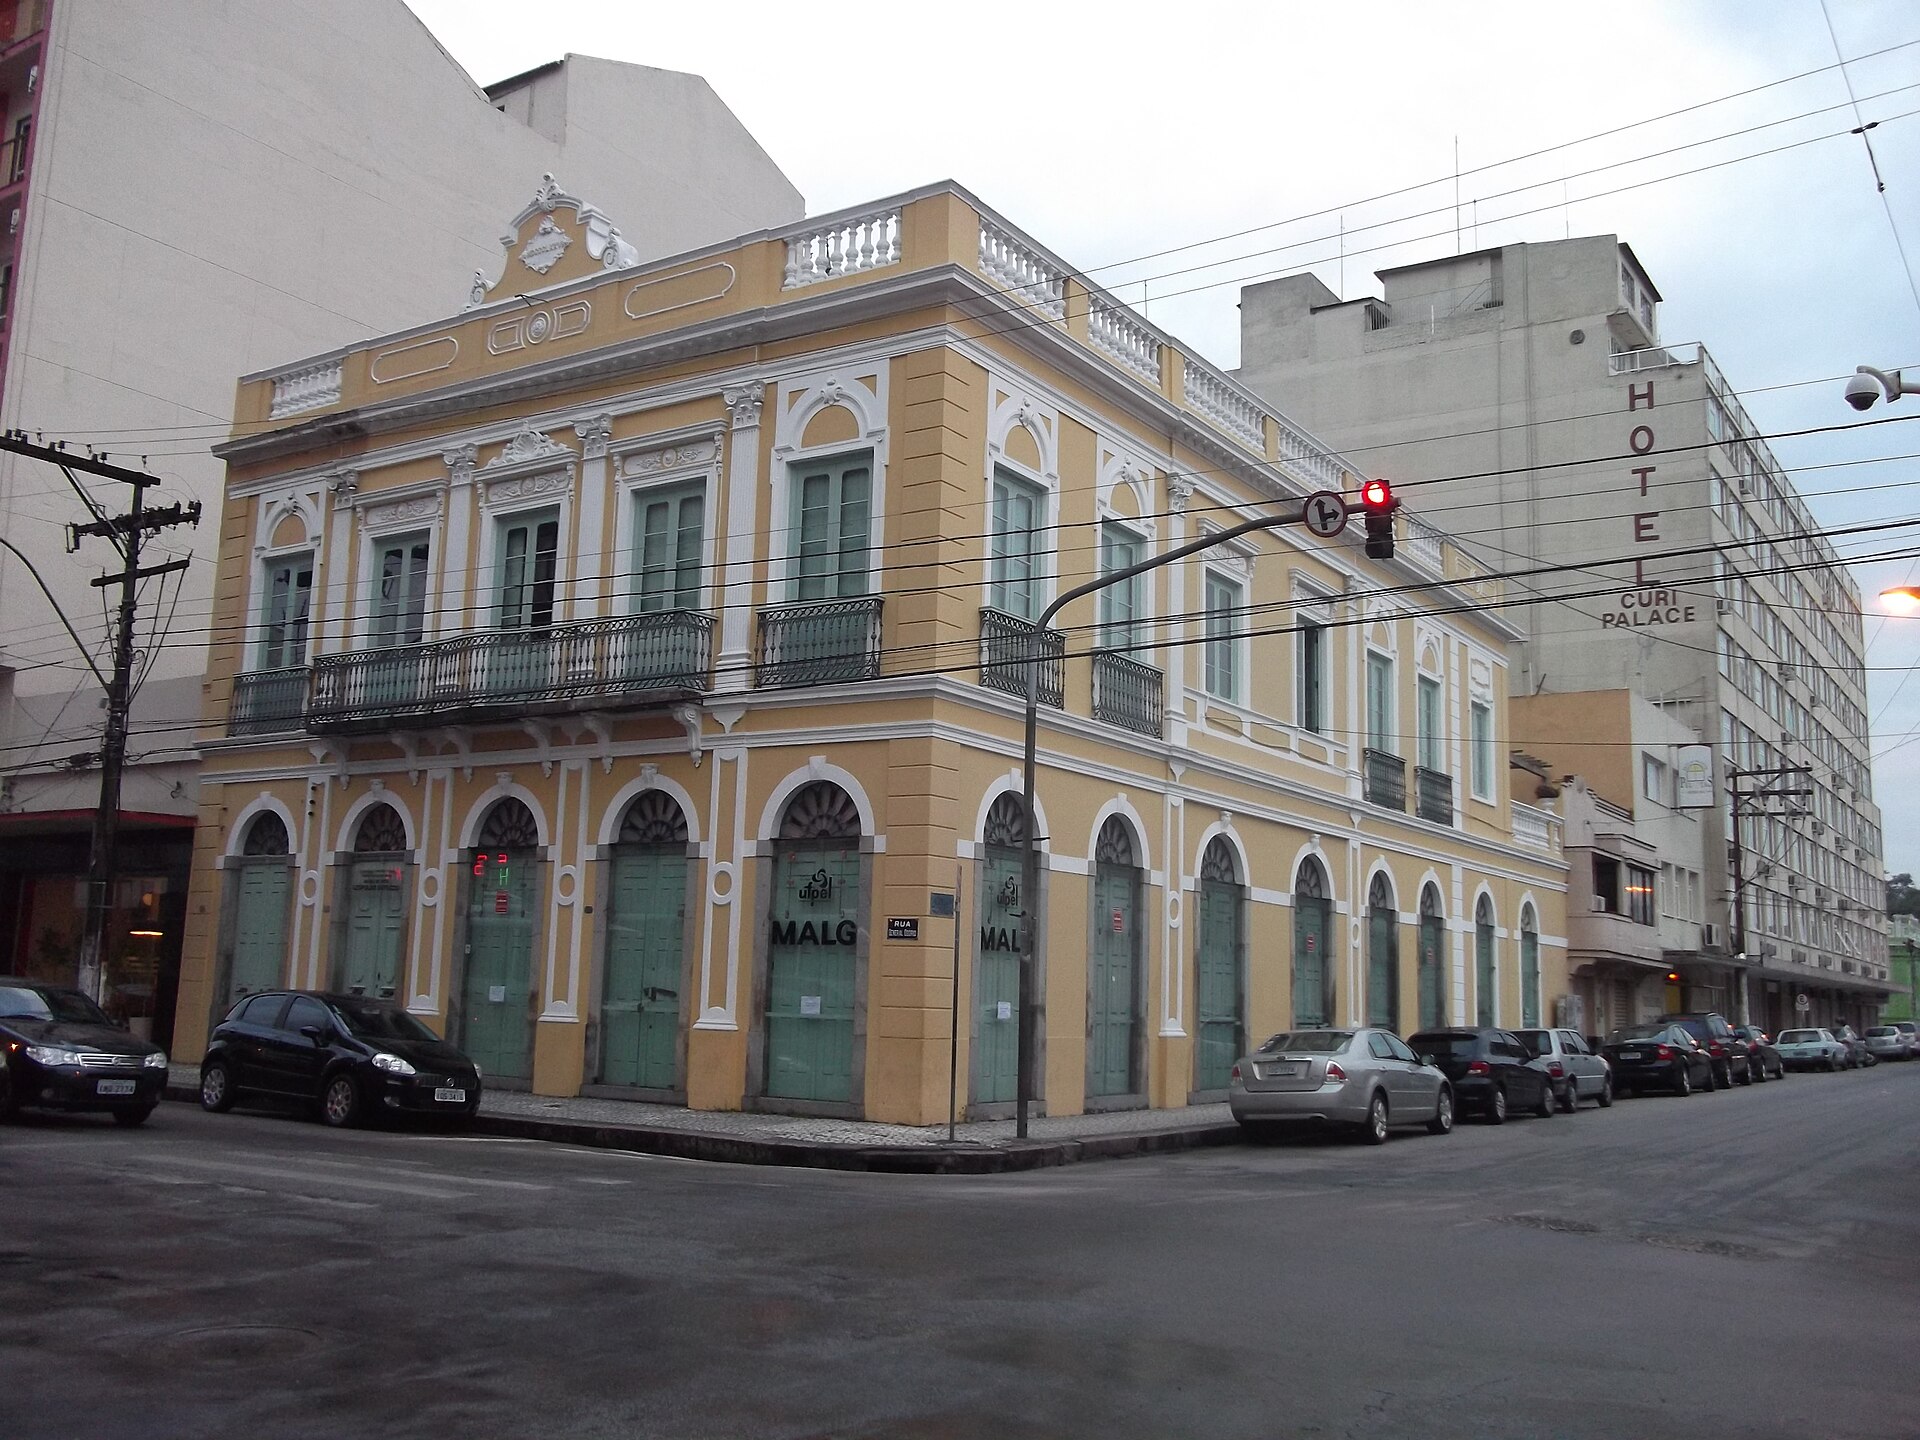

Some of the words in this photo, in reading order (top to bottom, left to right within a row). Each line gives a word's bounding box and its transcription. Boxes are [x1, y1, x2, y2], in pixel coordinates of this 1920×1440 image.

[1628, 381, 1661, 587] HOTEL
[1620, 590, 1677, 609] CURI
[1602, 606, 1695, 629] PALACE
[799, 876, 833, 907] ufpel
[772, 920, 858, 946] MALG
[894, 920, 911, 928] RUA
[981, 926, 1021, 953] MAL
